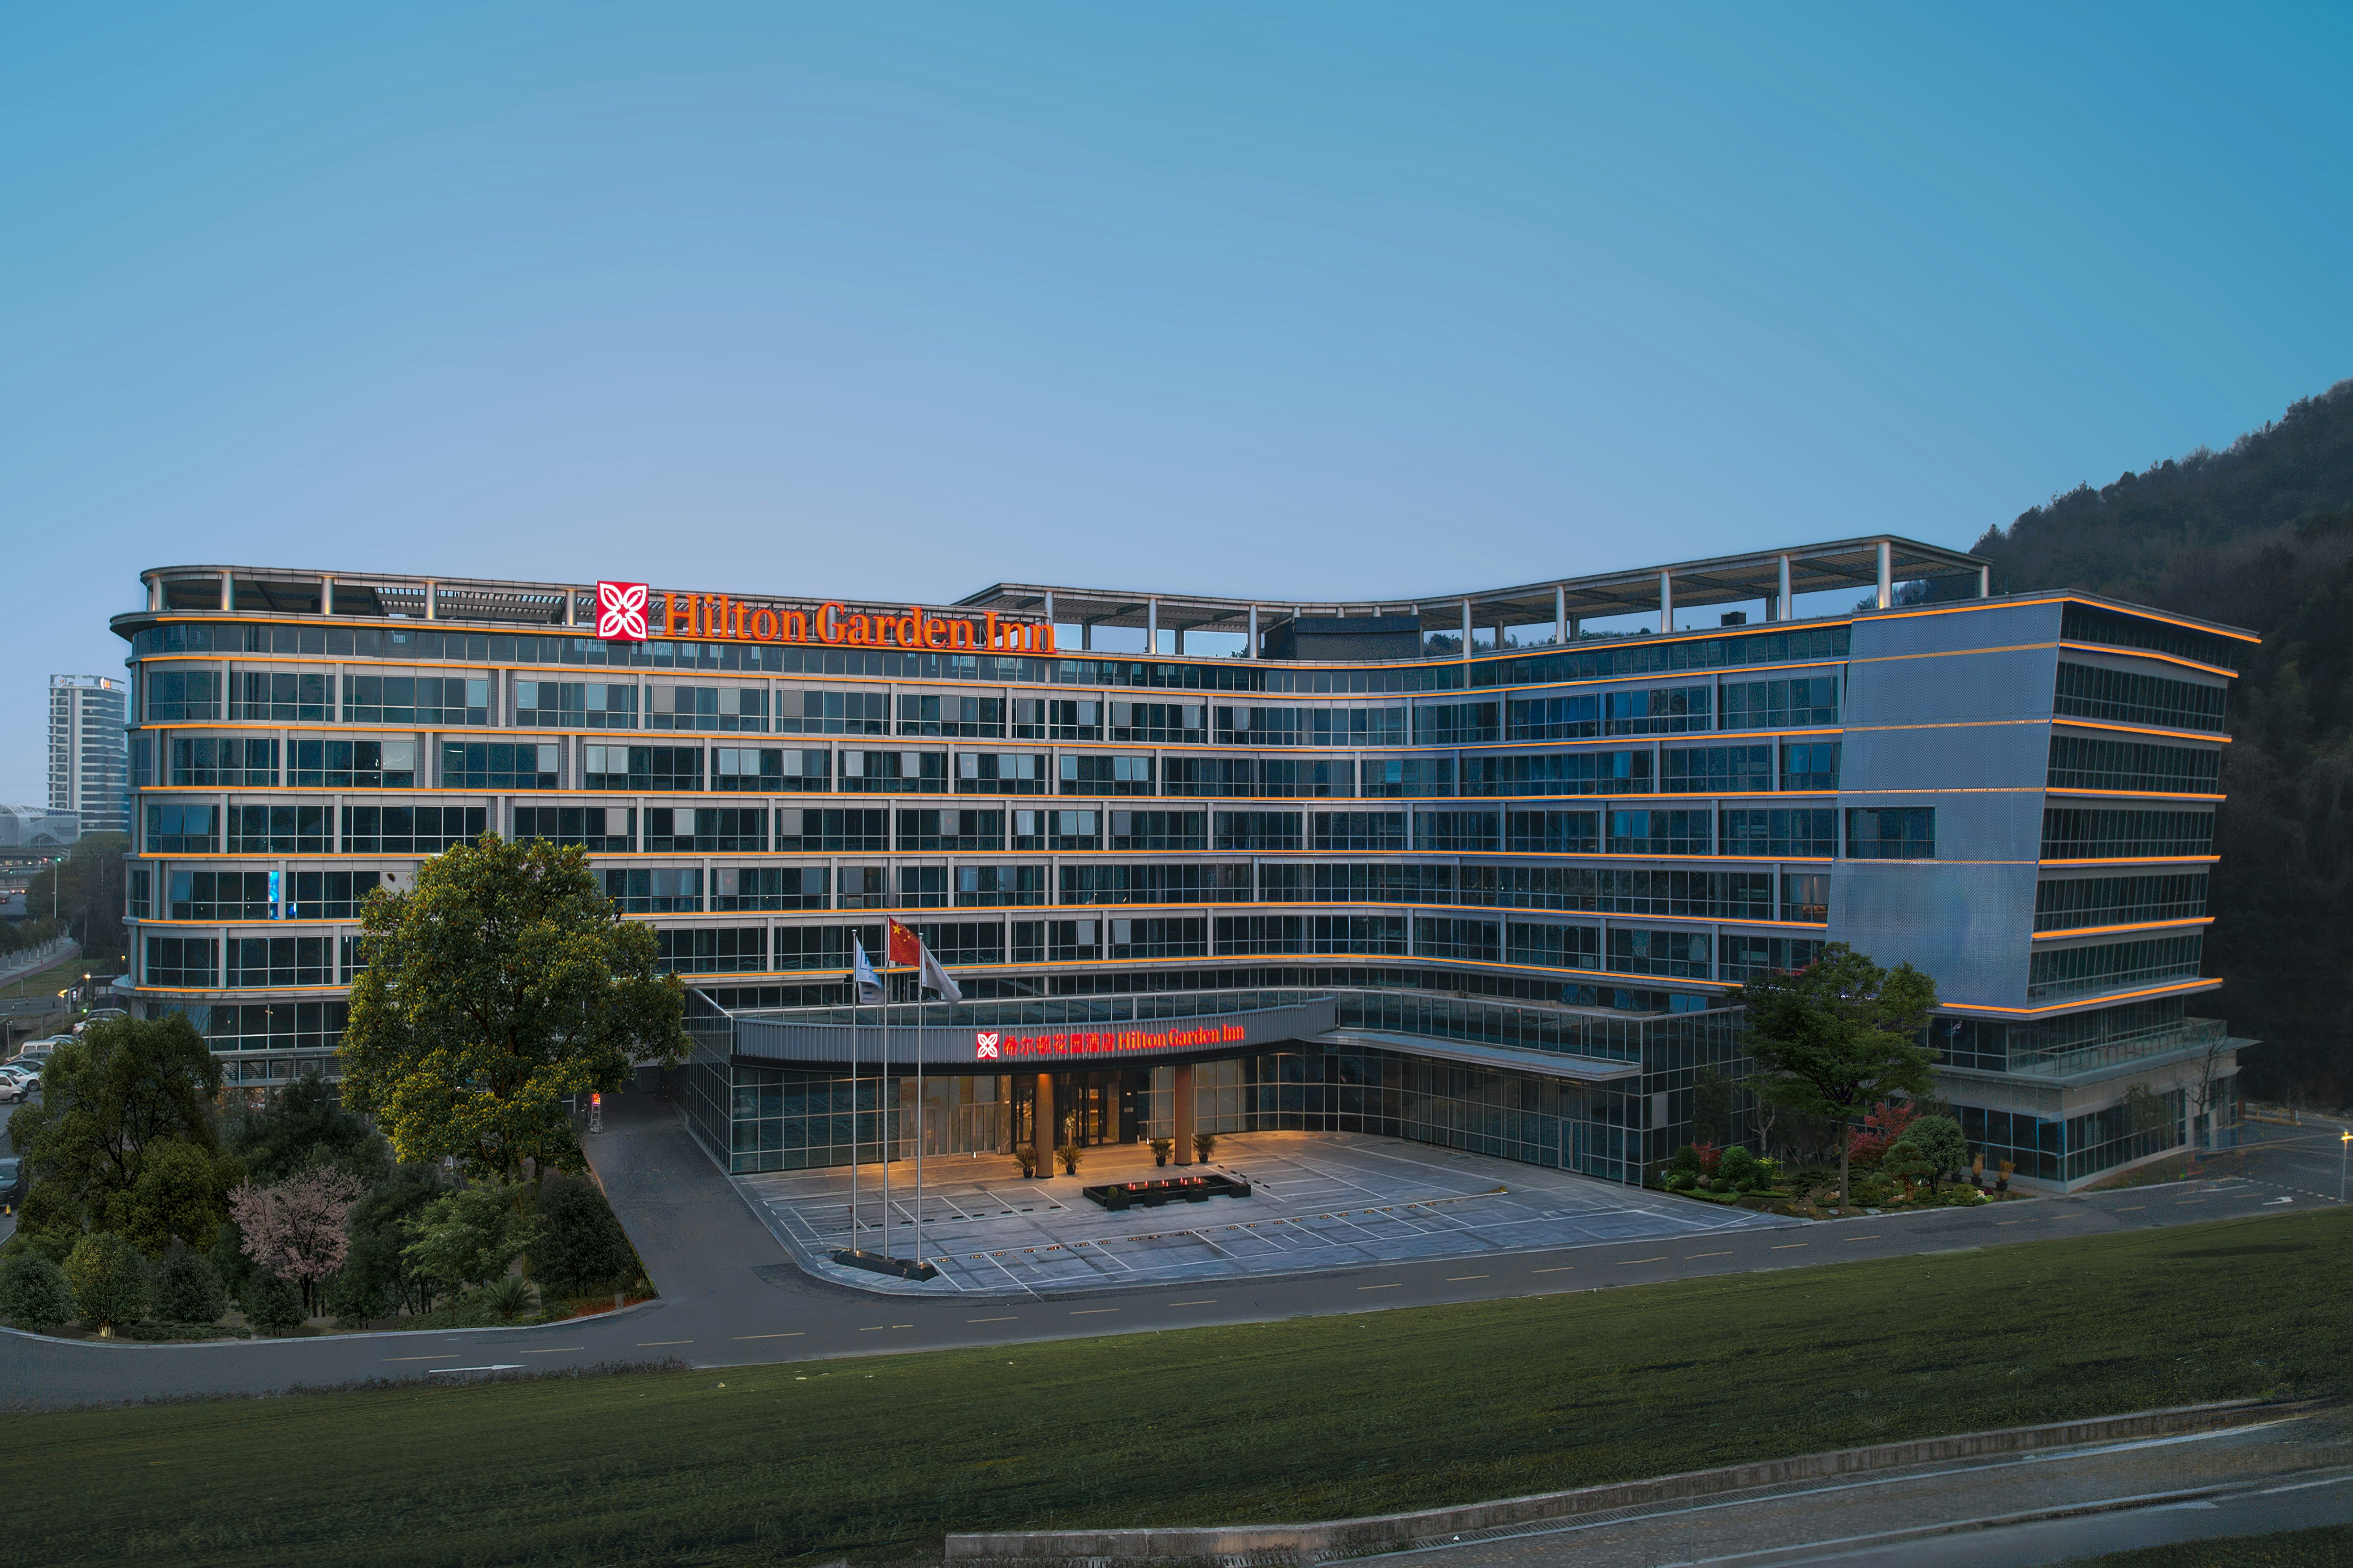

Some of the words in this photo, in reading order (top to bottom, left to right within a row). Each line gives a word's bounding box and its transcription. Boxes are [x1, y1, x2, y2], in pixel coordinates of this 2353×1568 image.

[663, 592, 807, 642] Hilton
[816, 601, 976, 650] Garden
[983, 611, 1058, 653] Inn
[1002, 1032, 1115, 1056] 希尔顿花园酒店
[1118, 1030, 1166, 1051] Hilton
[1168, 1026, 1220, 1047] Garden
[1222, 1023, 1245, 1042] Inn
